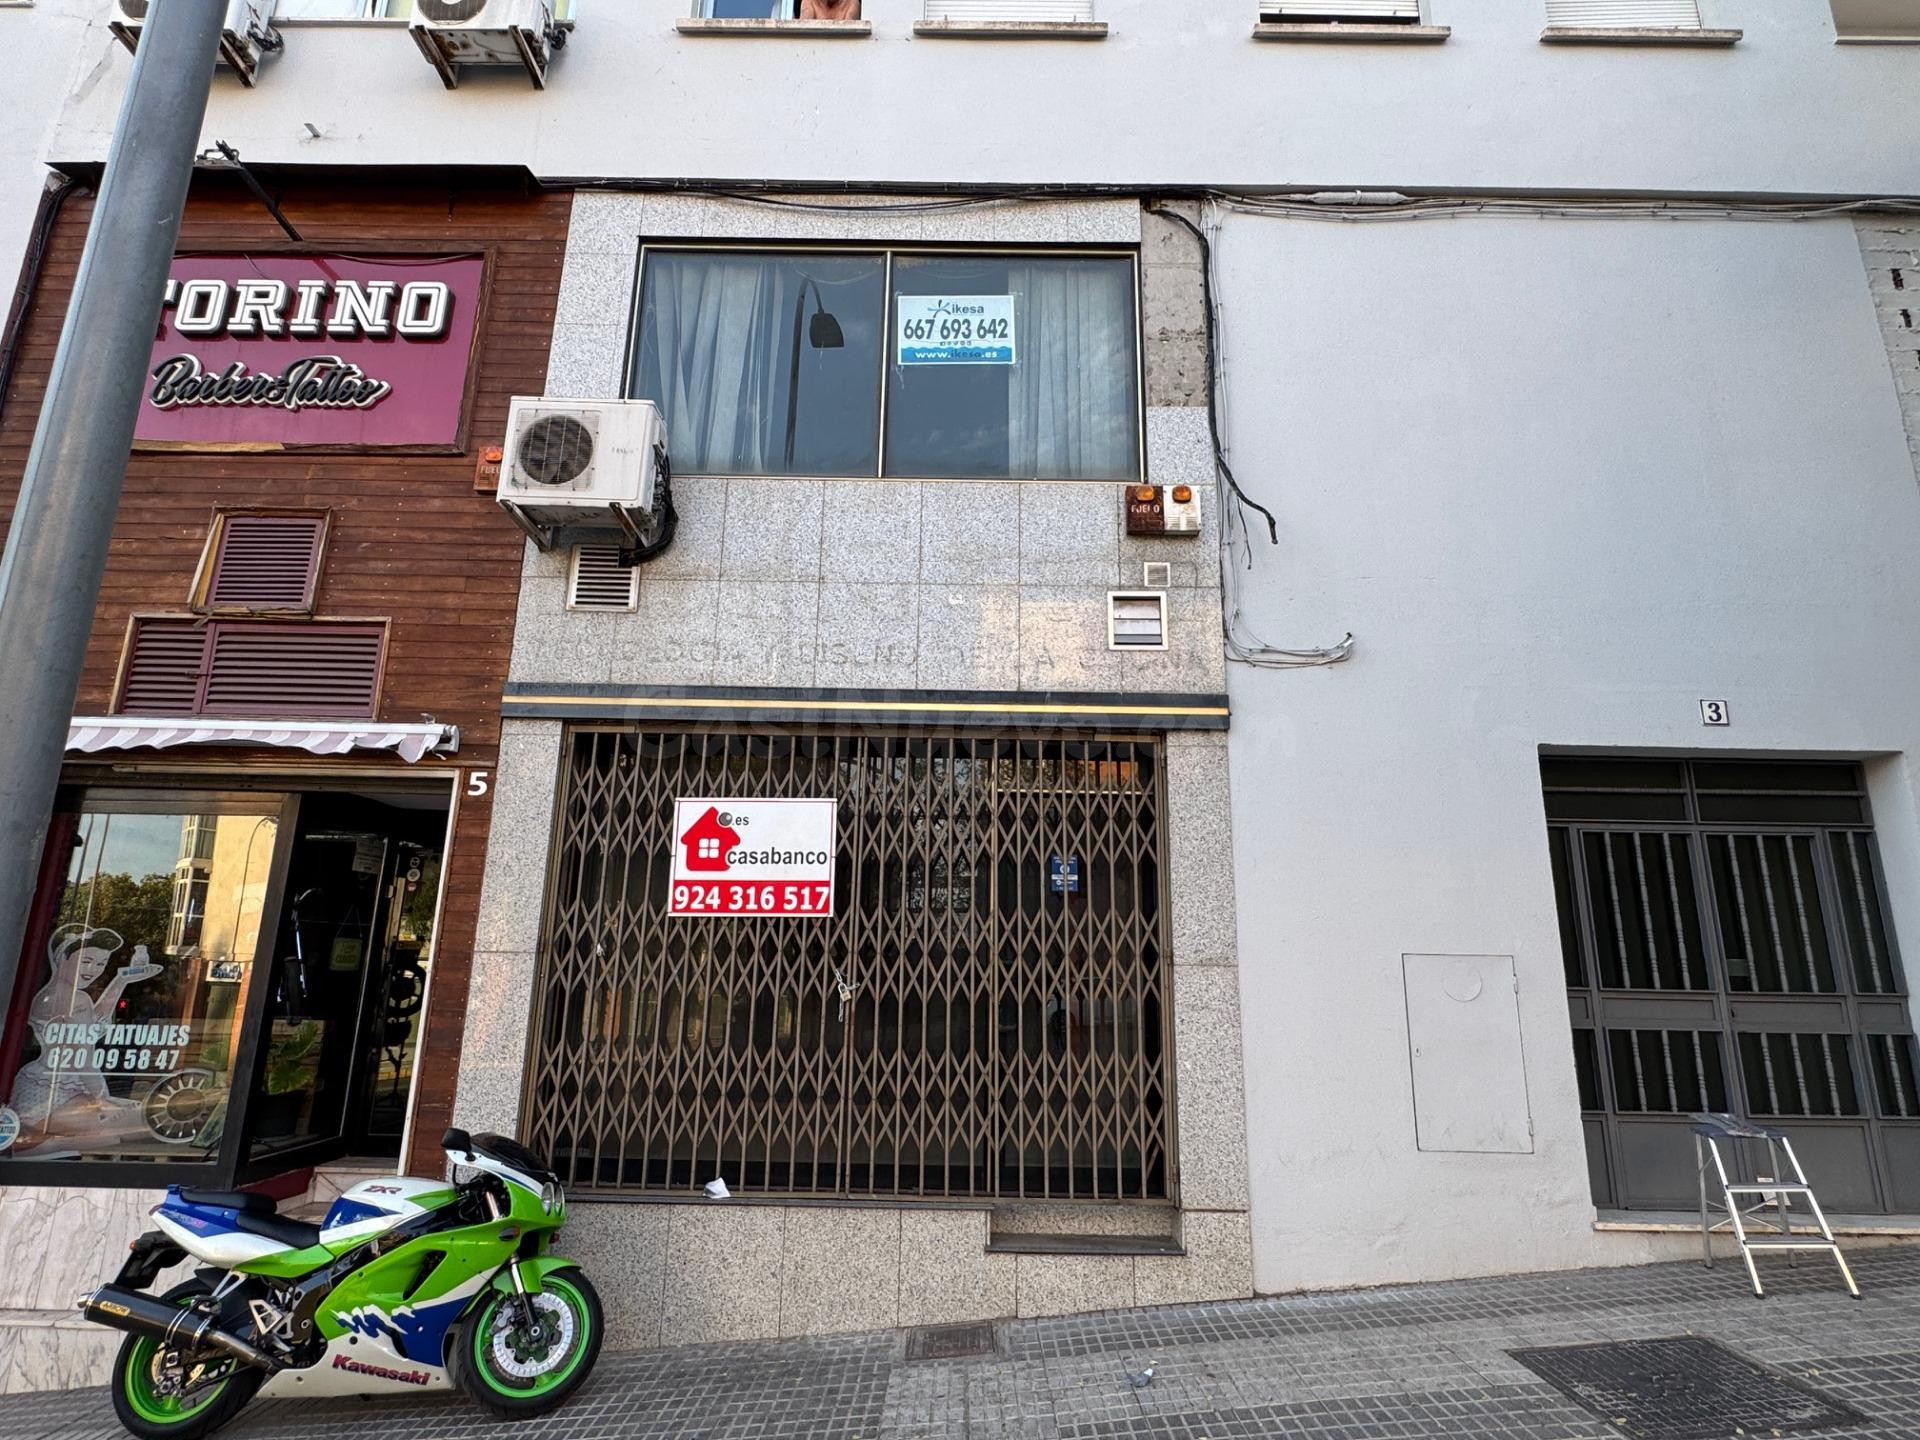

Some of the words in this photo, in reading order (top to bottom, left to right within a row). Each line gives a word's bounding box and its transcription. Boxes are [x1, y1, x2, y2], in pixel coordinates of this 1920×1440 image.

[952, 304, 984, 314] ikesa
[903, 319, 935, 340] 667
[940, 319, 971, 340] 693
[976, 318, 1008, 339] 642
[915, 350, 998, 359] www.ikesa.es
[1707, 702, 1722, 722] 3
[467, 771, 489, 796] 5
[727, 847, 828, 865] casabanco
[674, 885, 721, 910] 924
[728, 885, 775, 910] 316
[783, 886, 830, 910] 517
[45, 1023, 100, 1045] CITAS
[103, 1024, 191, 1046] TATUAJES
[47, 1047, 88, 1069] 620
[92, 1048, 120, 1069] 09
[124, 1049, 151, 1070] 58
[154, 1050, 180, 1071] 47
[332, 1353, 431, 1386] Kawasaki
